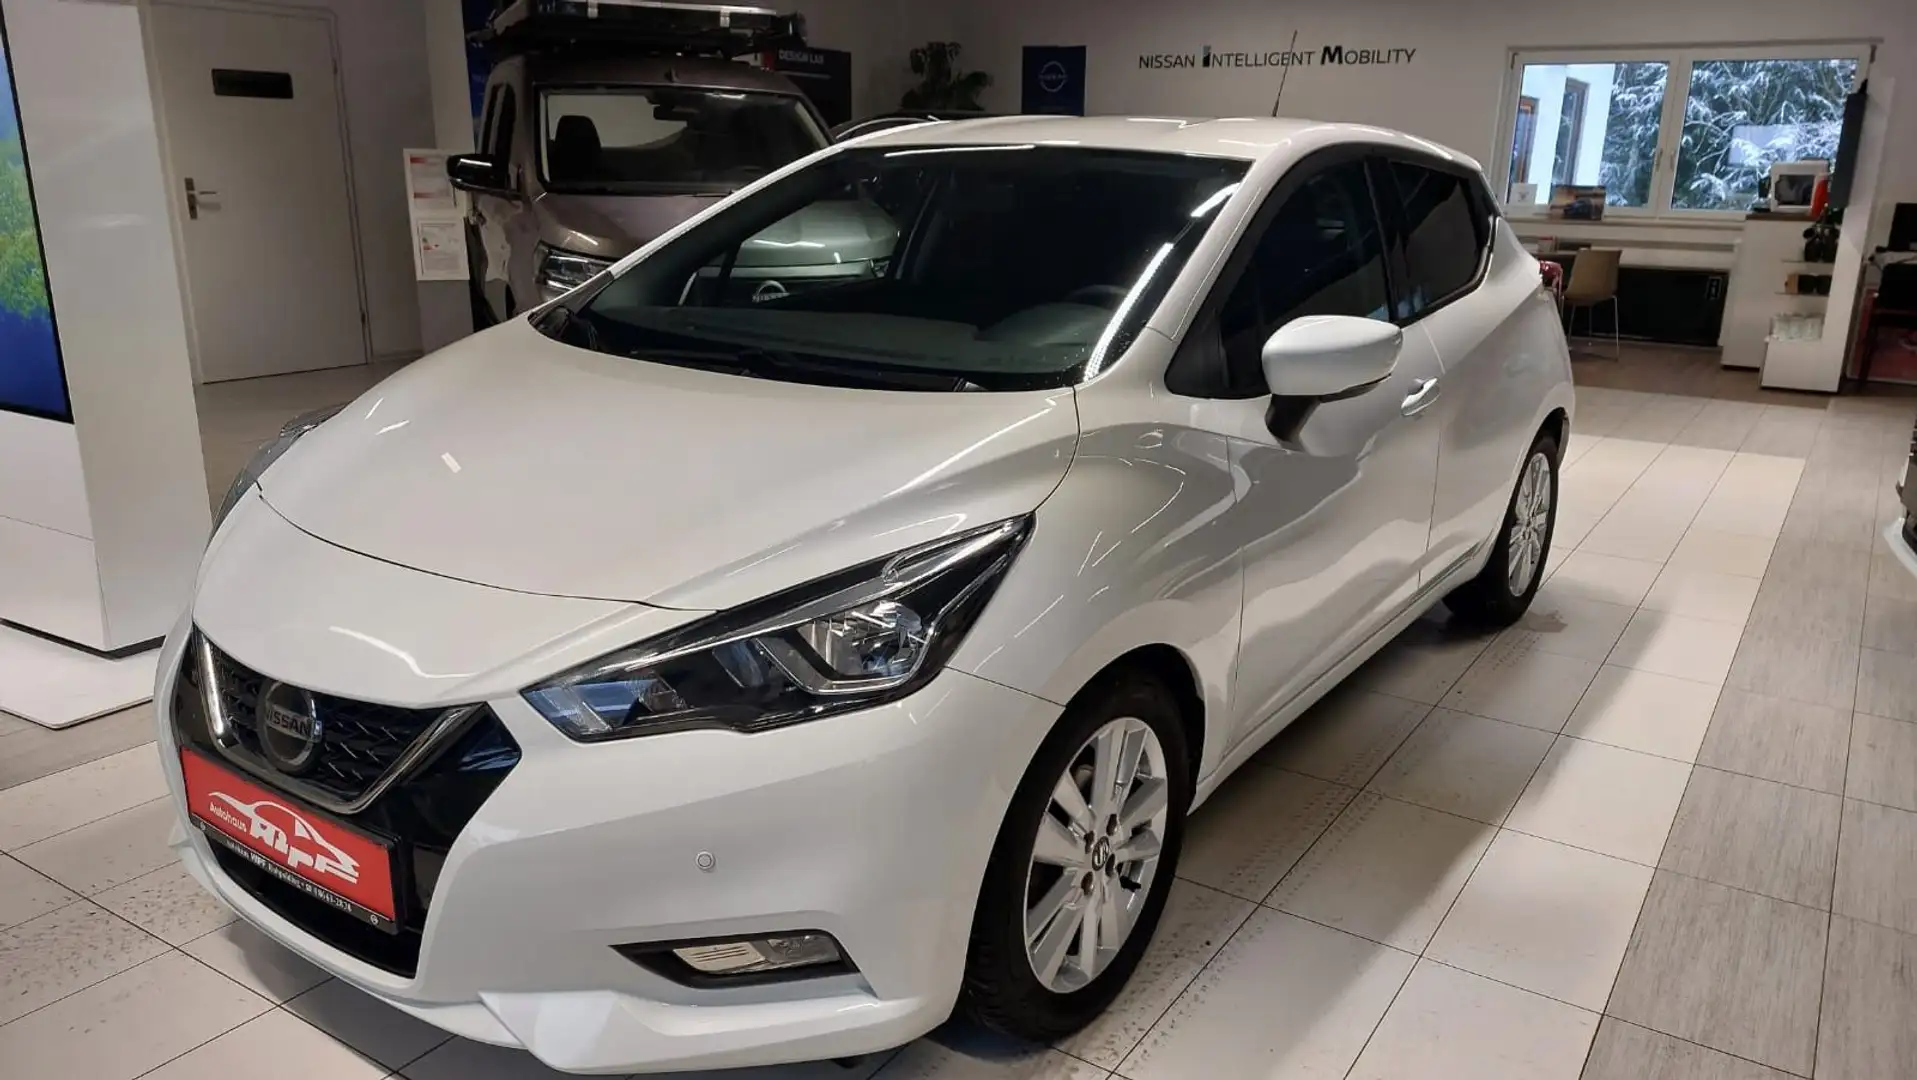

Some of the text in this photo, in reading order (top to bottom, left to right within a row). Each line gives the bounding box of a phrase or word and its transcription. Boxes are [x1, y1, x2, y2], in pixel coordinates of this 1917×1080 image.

[1139, 54, 1195, 69] NISSAN
[1320, 45, 1416, 65] MOBILITY
[266, 708, 311, 738] NISSAN
[209, 801, 247, 833] Autohaus
